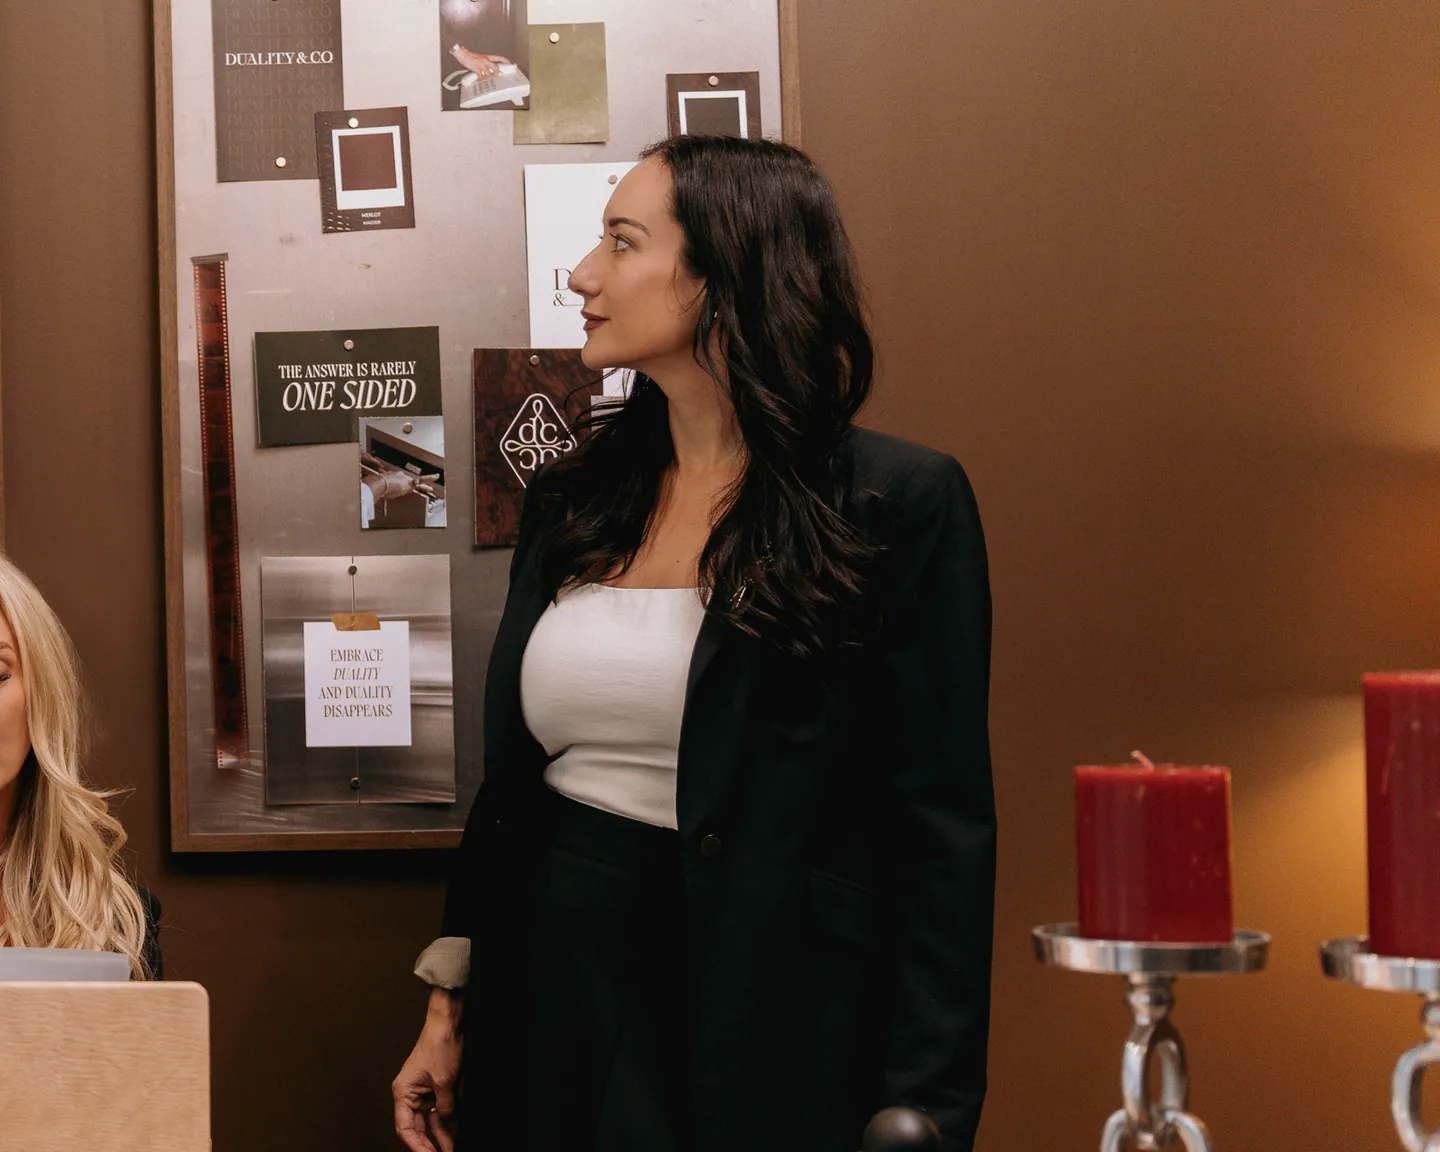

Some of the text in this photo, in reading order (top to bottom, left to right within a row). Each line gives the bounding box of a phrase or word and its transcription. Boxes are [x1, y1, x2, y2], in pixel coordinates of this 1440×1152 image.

[225, 50, 334, 66] DUALITY & CO
[278, 360, 416, 378] THE ANSWER IS RARELY
[282, 378, 417, 411] ONE SIDED
[330, 649, 384, 662] EMBRACE
[334, 668, 381, 680] DUALITY
[318, 686, 393, 699] AND DUALITY
[324, 704, 393, 717] DISAPPEARS
